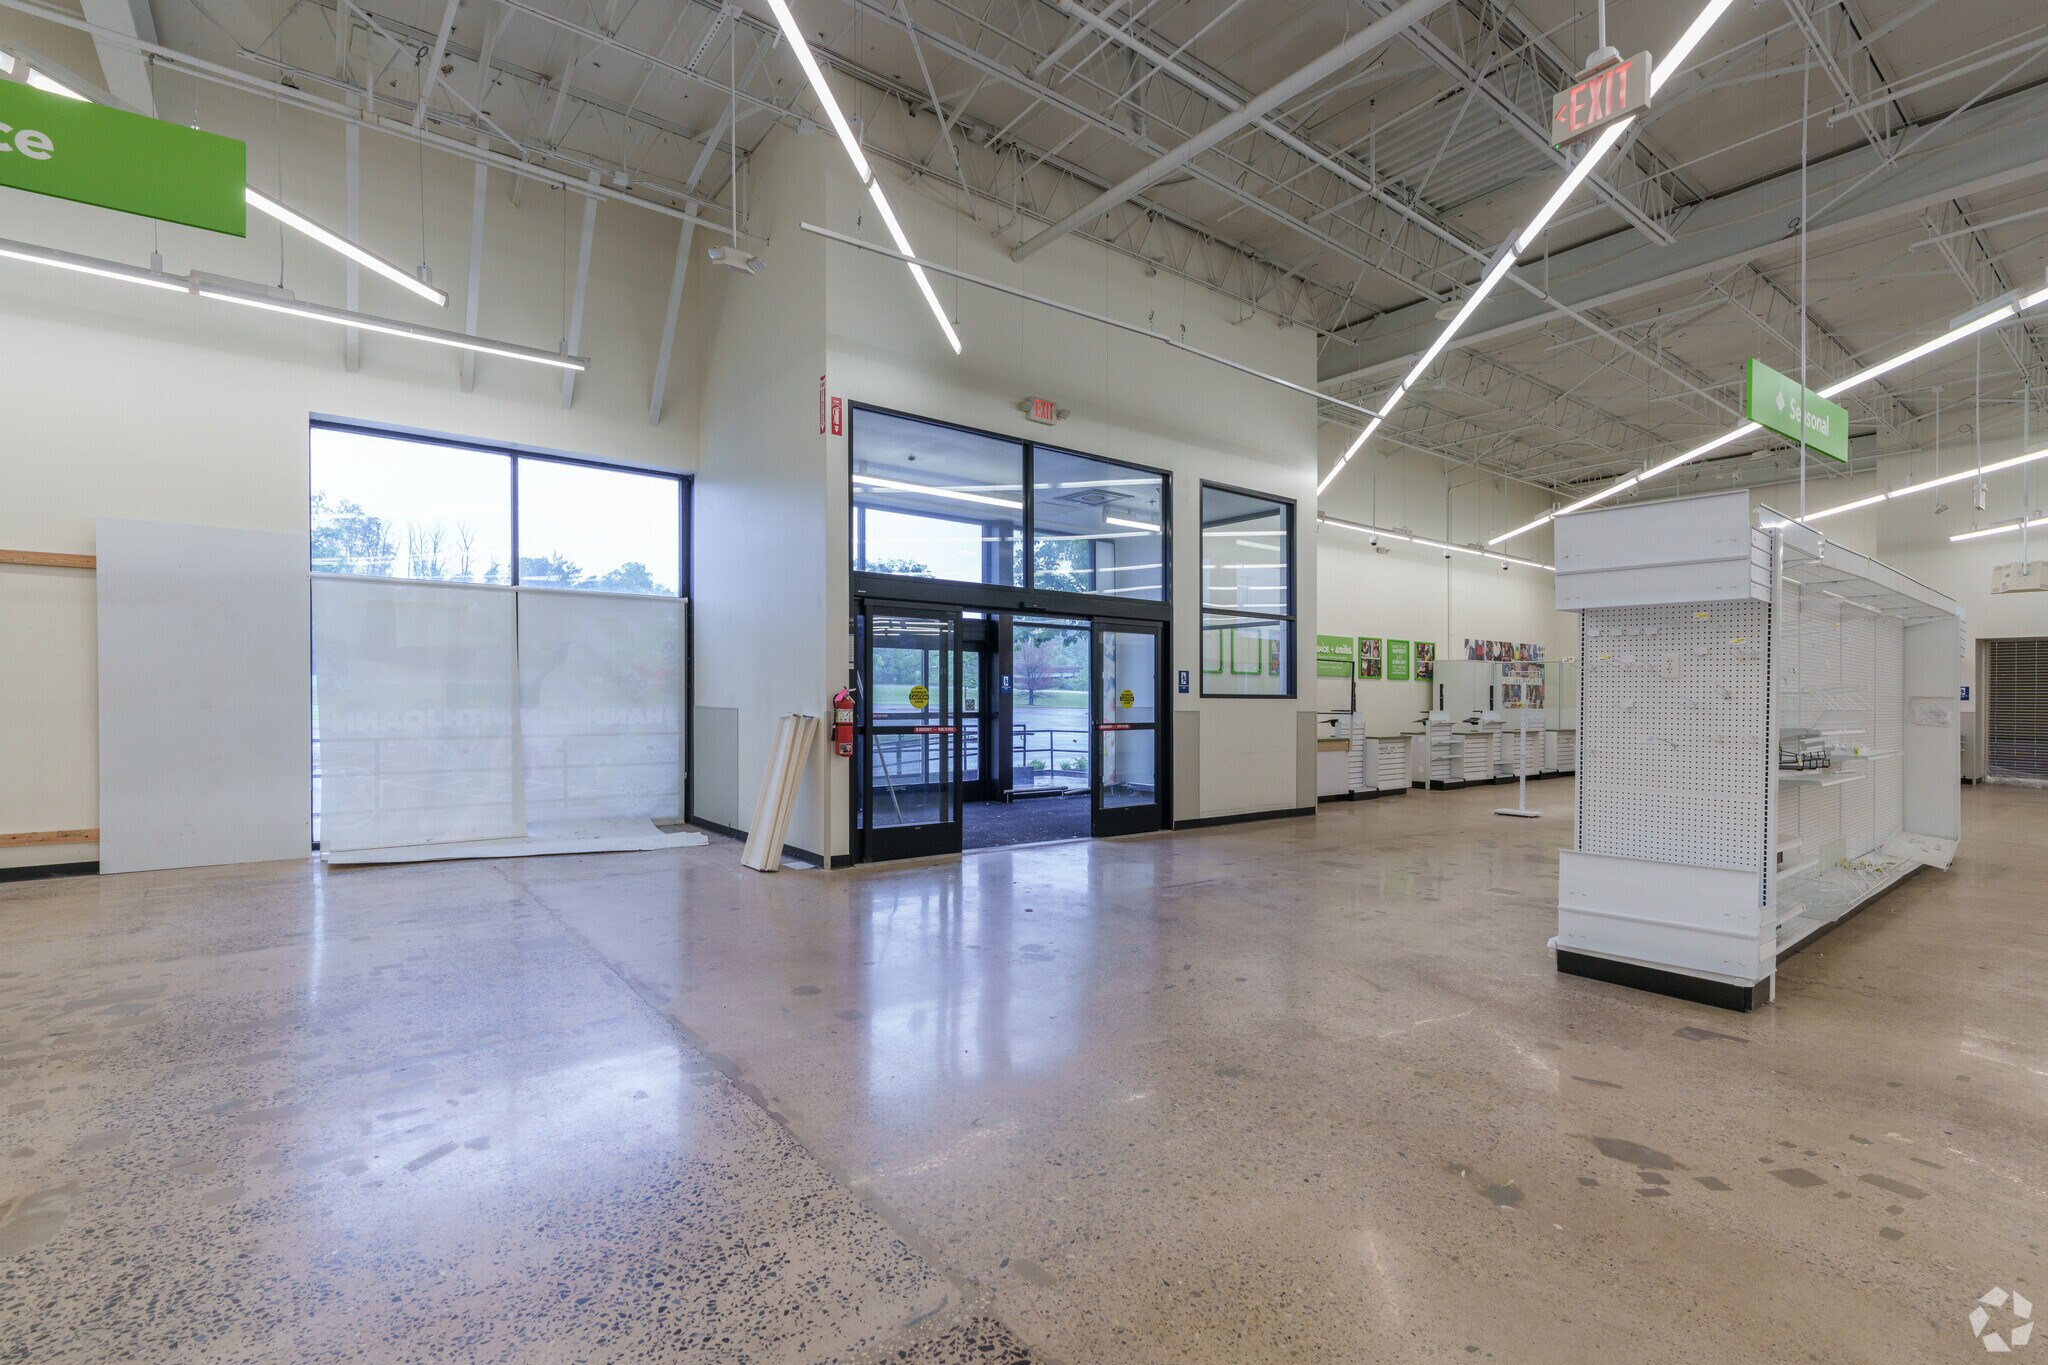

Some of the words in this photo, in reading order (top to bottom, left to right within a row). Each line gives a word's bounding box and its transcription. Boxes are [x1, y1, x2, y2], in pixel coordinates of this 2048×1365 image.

[1568, 60, 1633, 132] EXIT
[1035, 399, 1054, 421] EXIT
[1789, 397, 1830, 437] Sesonal
